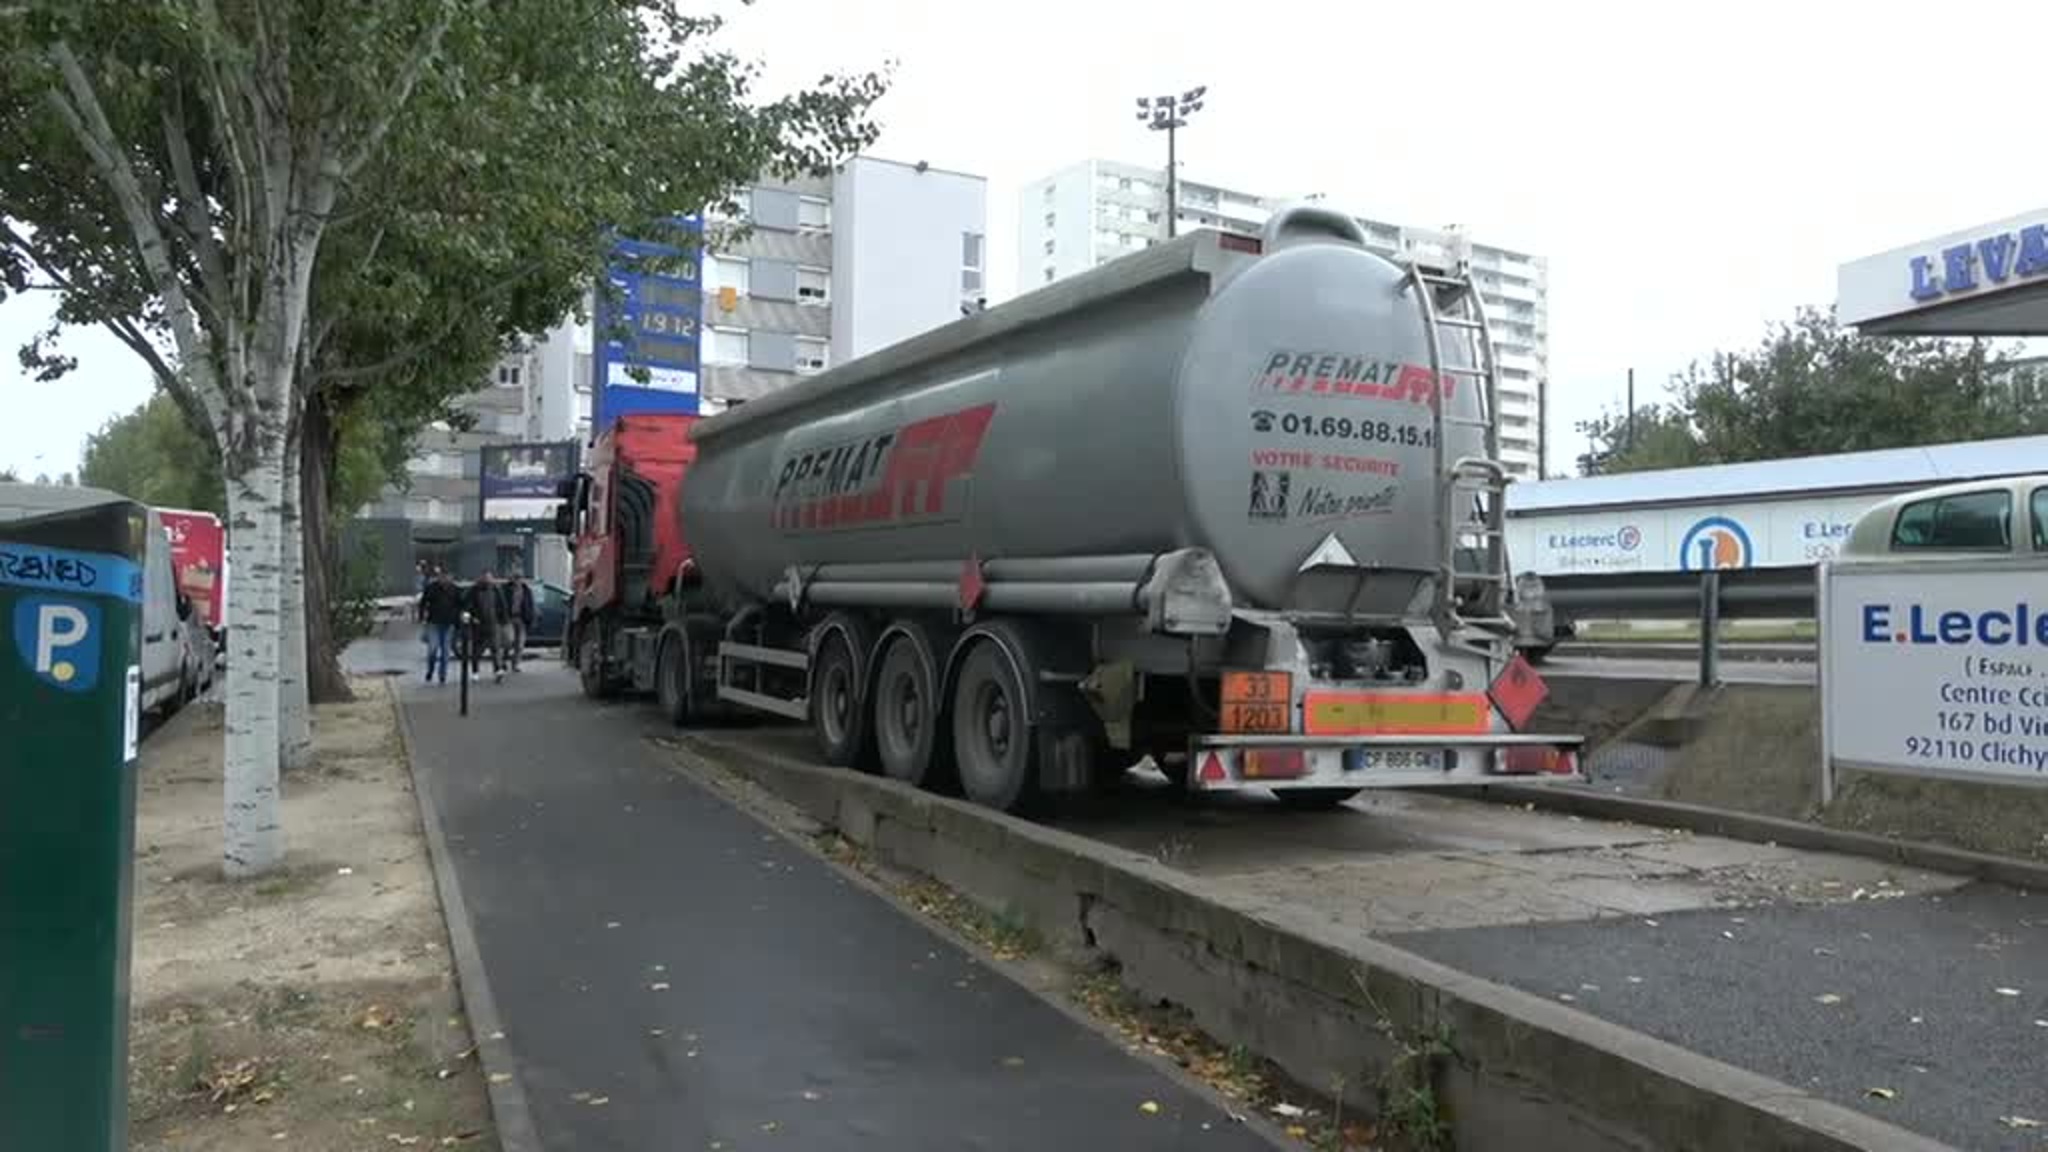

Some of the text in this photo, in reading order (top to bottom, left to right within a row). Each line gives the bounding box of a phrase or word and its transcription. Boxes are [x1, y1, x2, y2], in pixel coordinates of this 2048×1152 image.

[1264, 352, 1399, 386] PREMAT
[775, 433, 897, 499] PREMAT
[1253, 451, 1313, 468] VOTRE
[1245, 674, 1272, 698] 33
[1941, 683, 2012, 705] Centre
[1231, 706, 1284, 729] 1203
[1938, 711, 1975, 732] 167
[1984, 711, 2012, 734] bd
[1906, 736, 1974, 760] 92110
